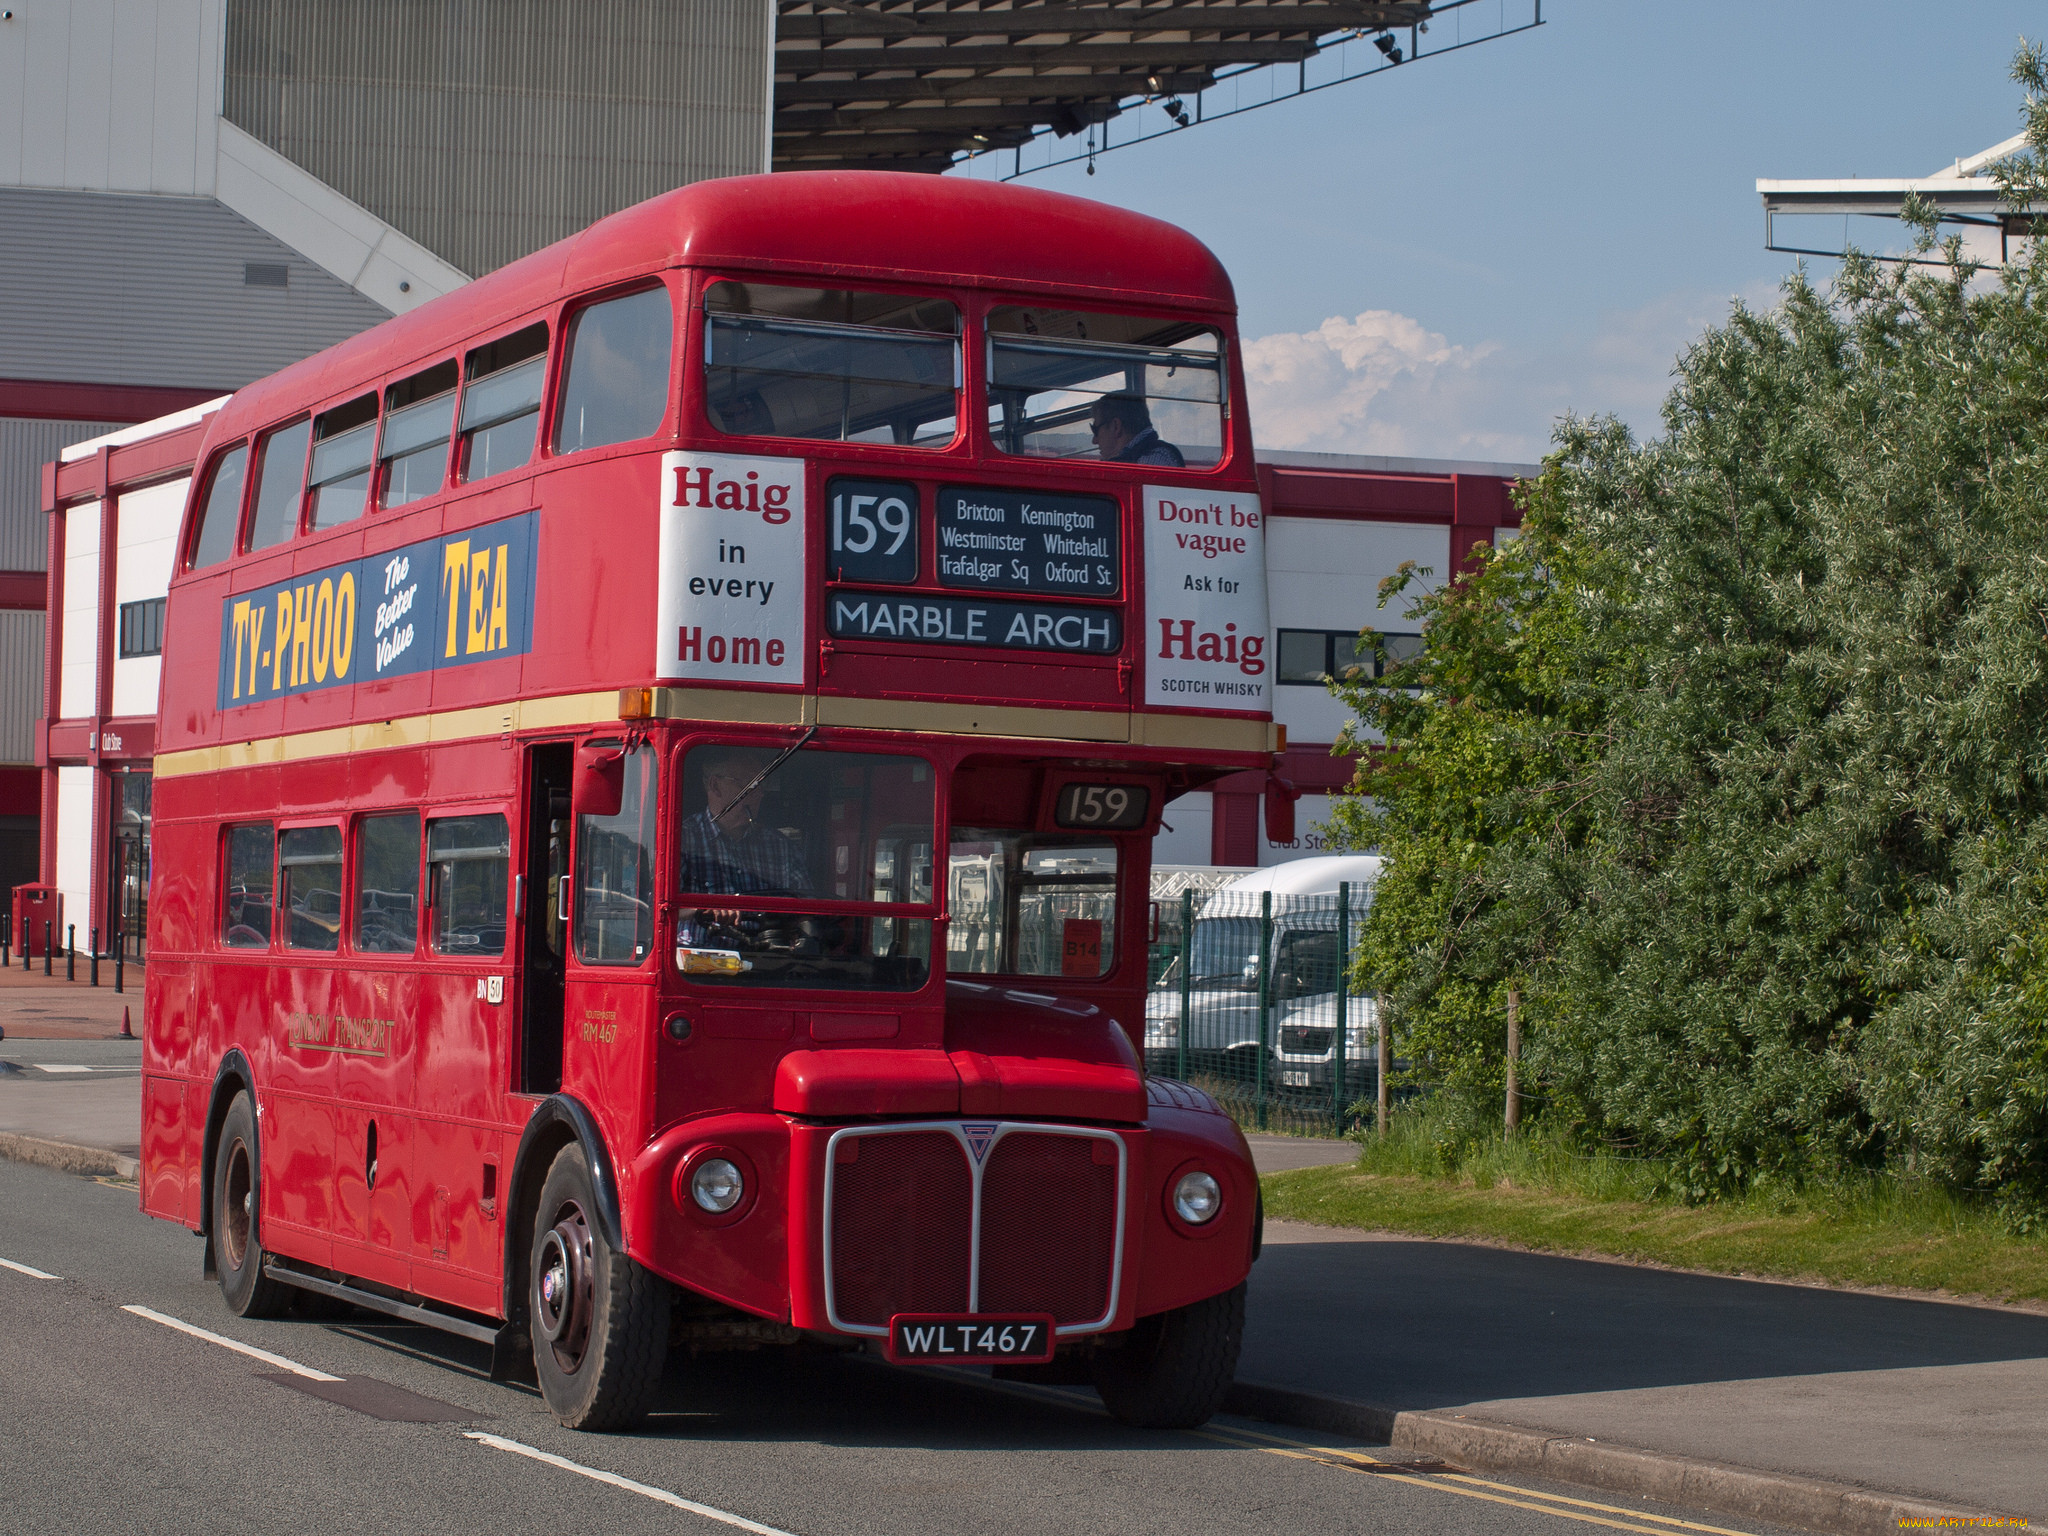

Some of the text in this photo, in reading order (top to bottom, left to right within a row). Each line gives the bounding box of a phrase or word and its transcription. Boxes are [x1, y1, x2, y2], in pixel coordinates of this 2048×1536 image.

[673, 466, 791, 525] Haig
[833, 494, 910, 555] 159
[957, 499, 1094, 531] Brixton Kennington
[1158, 500, 1259, 528] Don't be
[719, 539, 745, 563] in
[941, 527, 1109, 557] Westminster Whitehall
[1176, 533, 1246, 559] vague
[385, 555, 409, 595] The
[940, 555, 1111, 585] Trafalgar Sq Oxford St
[1184, 574, 1239, 594] Ask for
[442, 538, 508, 658] TEA
[689, 576, 774, 605] every
[374, 584, 417, 638] Better
[835, 600, 1110, 649] MARBLE ARCH
[232, 572, 355, 699] TY-PHOO
[375, 623, 414, 672] Value
[678, 626, 785, 666] Home
[1158, 618, 1265, 676] Haig
[1161, 679, 1263, 697] SCOTCH WHISKY
[102, 732, 122, 751] Club Store
[1070, 786, 1128, 822] 159
[1066, 941, 1098, 957] B14
[477, 979, 500, 999] BN 50
[585, 1010, 616, 1020] ROUTEMASTER
[288, 1012, 395, 1057] LONDON TRANSPORT
[903, 1325, 1037, 1353] WLT467
